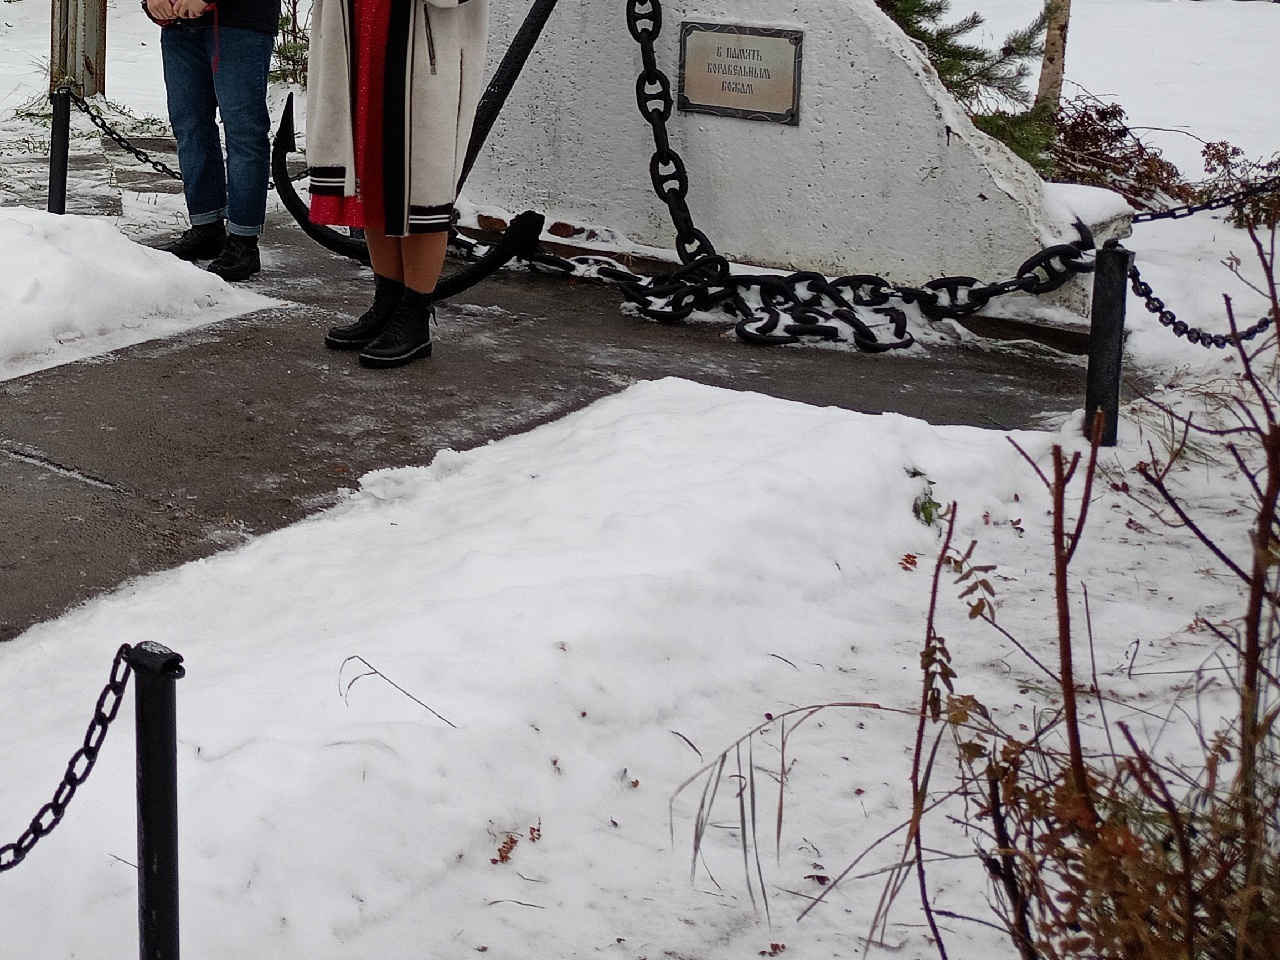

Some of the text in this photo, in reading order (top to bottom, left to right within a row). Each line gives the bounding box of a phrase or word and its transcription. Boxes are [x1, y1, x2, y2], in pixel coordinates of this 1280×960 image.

[716, 46, 762, 61] В ПАМЯТЬ
[707, 62, 771, 79] КОРАБЕЛЬНЫМ
[721, 80, 754, 95] ВОЖАМ
